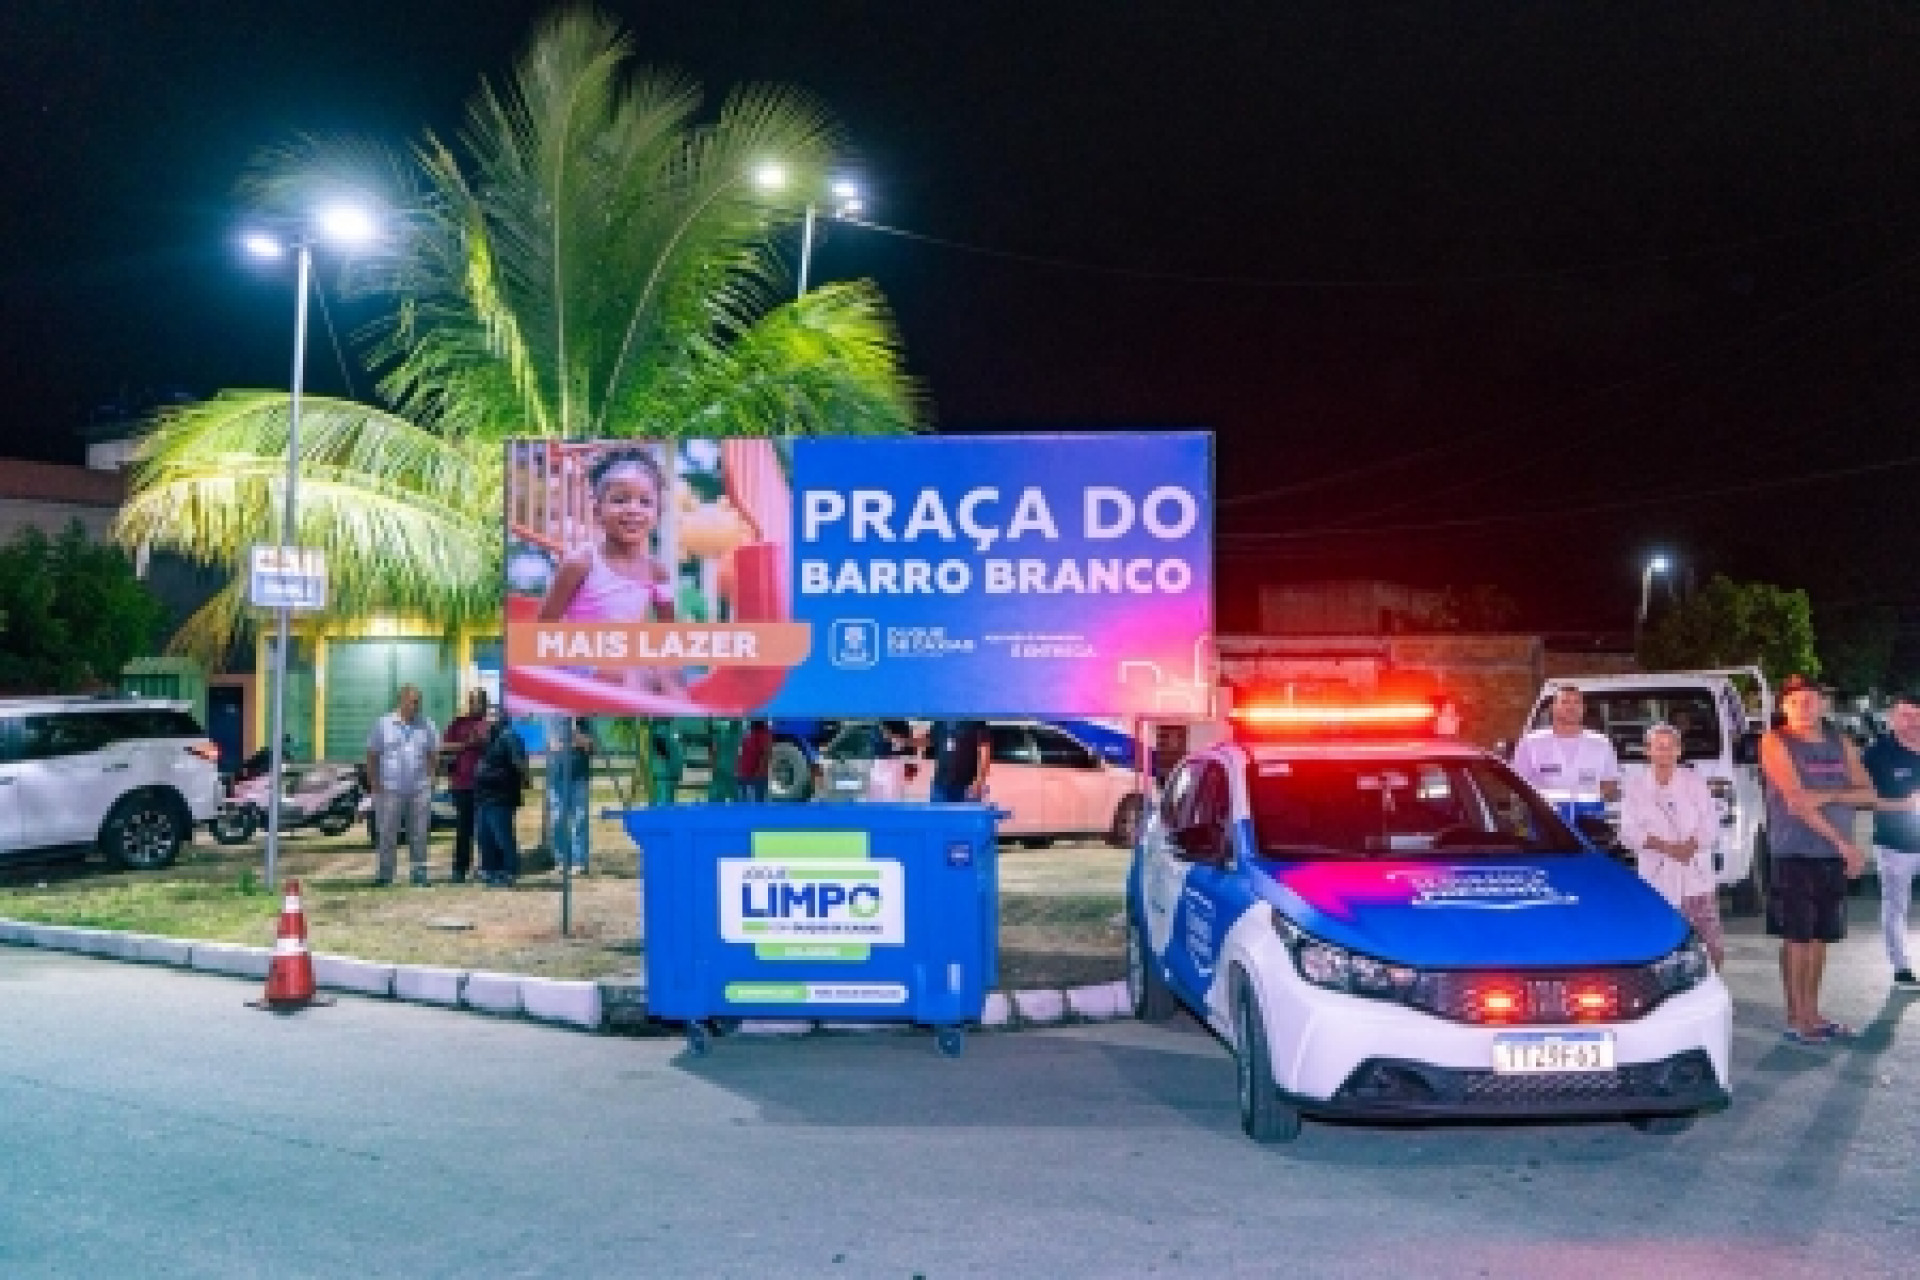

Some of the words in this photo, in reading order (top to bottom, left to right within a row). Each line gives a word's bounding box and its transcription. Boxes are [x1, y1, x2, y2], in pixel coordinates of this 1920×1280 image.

[802, 486, 1059, 552] PRAÇA
[1083, 486, 1199, 540] DO
[801, 559, 972, 594] BARRO
[984, 558, 1192, 594] BRANCO
[537, 630, 628, 658] MAIS
[638, 630, 760, 658] LAZER
[742, 883, 883, 918] LIMPO
